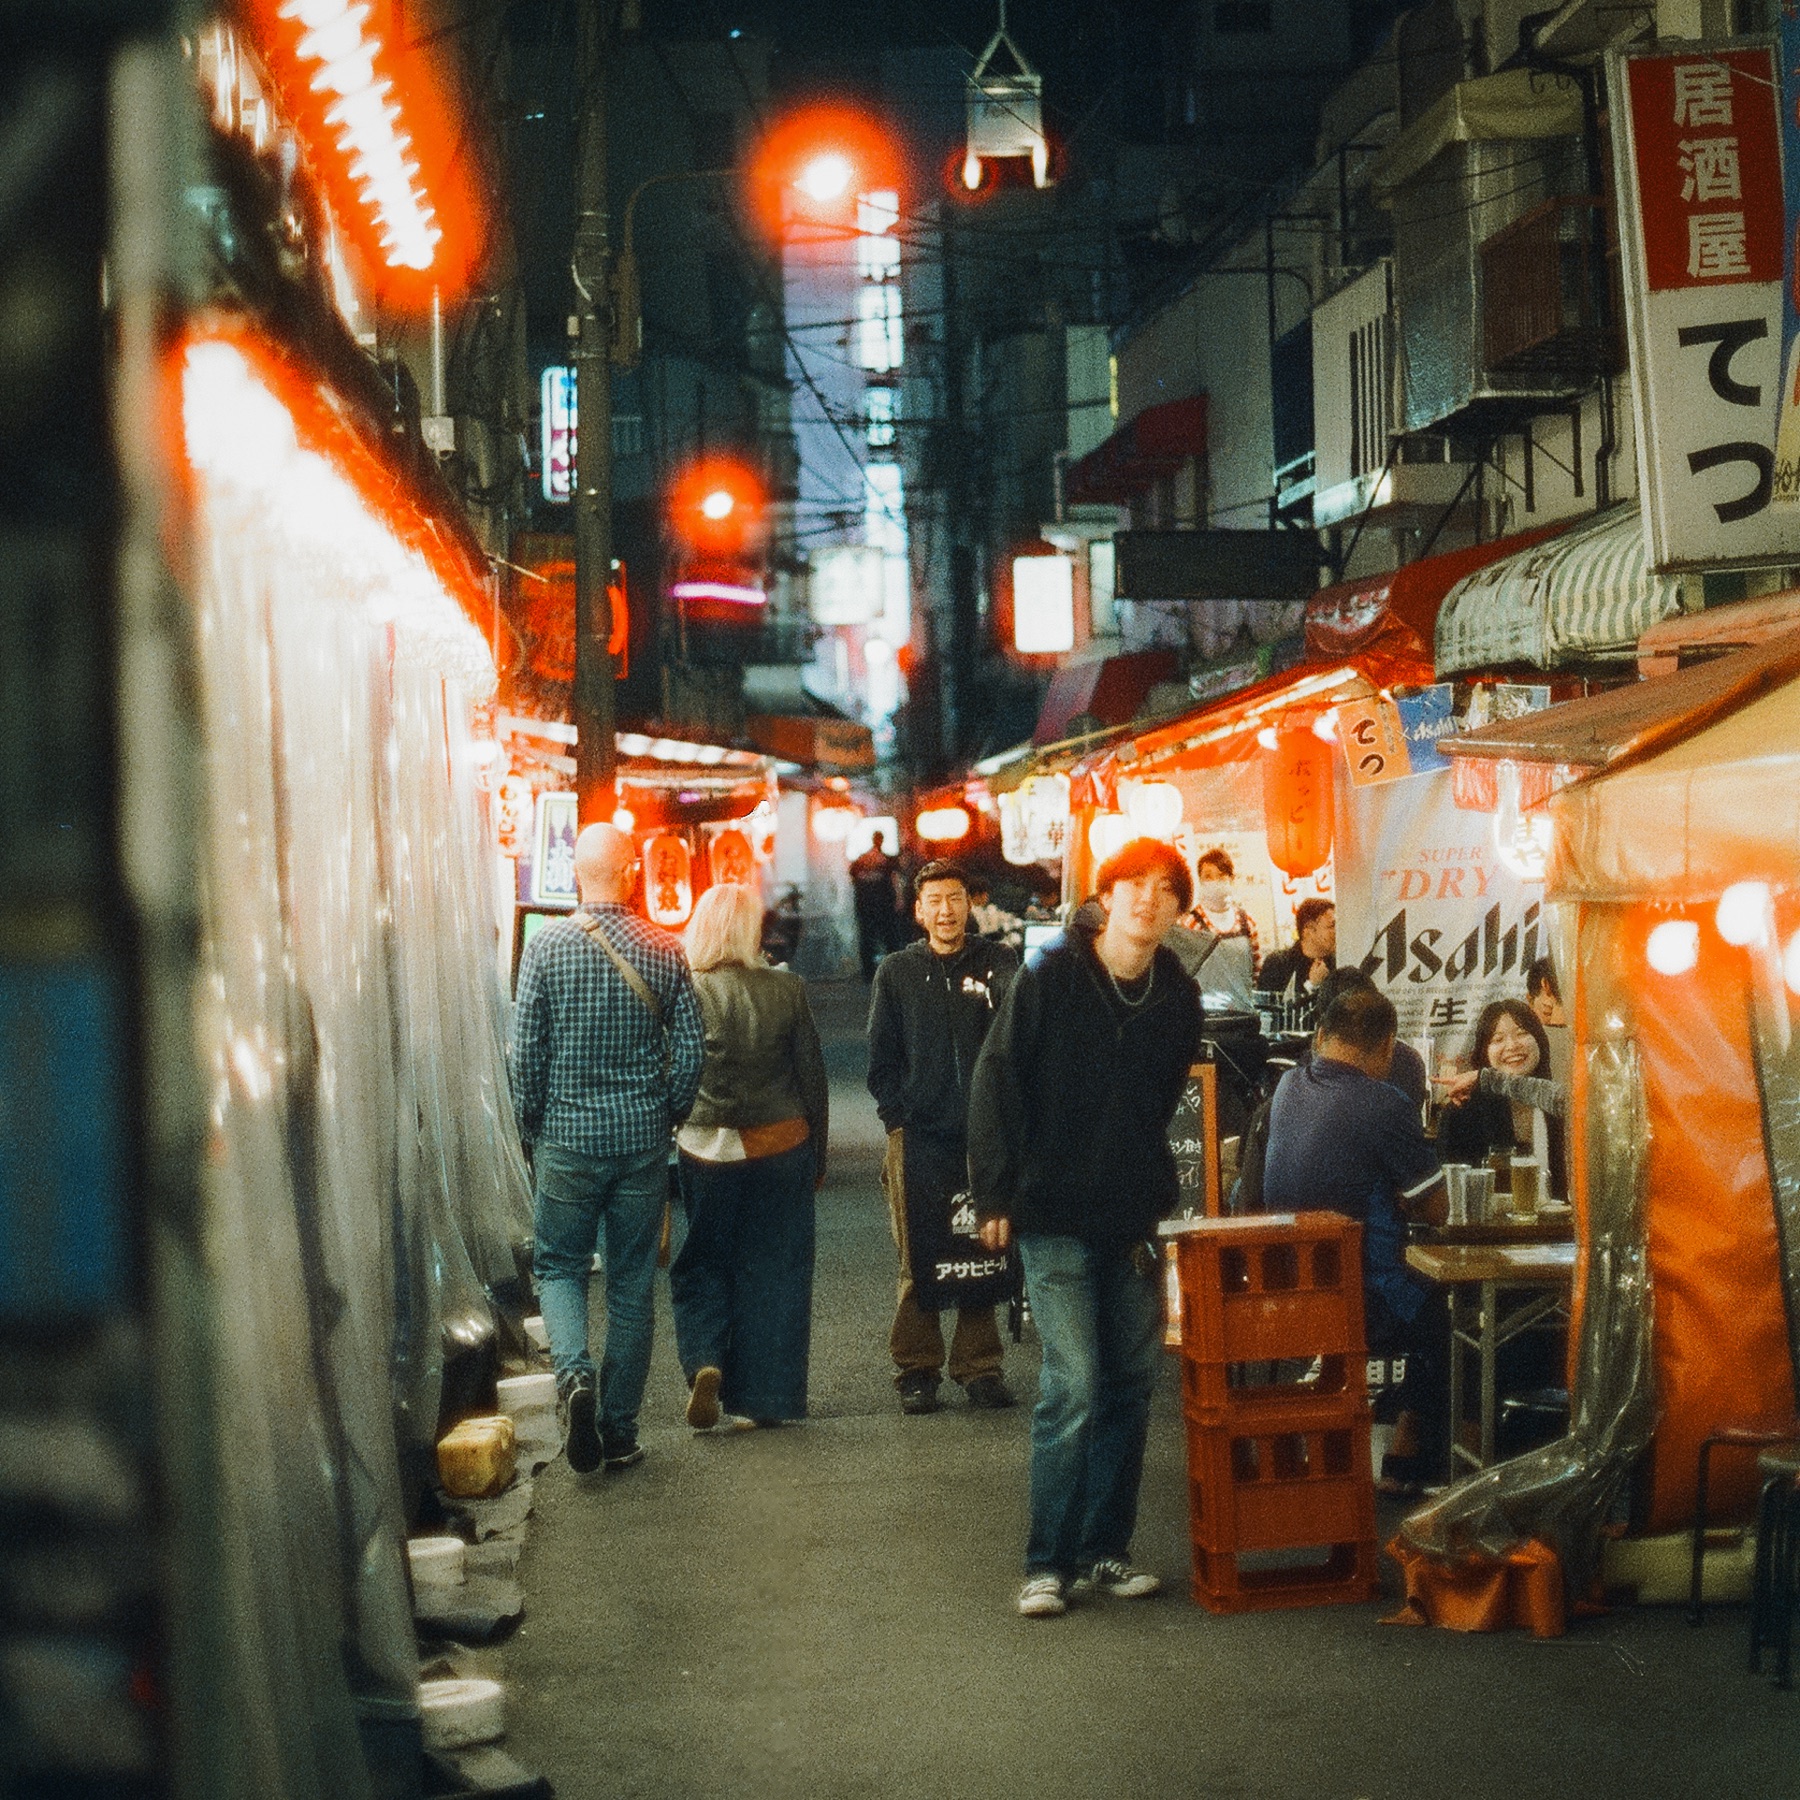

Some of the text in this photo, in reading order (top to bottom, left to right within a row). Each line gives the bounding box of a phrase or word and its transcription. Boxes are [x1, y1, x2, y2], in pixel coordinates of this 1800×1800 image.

[1672, 62, 1751, 278] 居酒屋
[1678, 317, 1776, 524] てつ
[1350, 718, 1385, 776] てつ
[1418, 846, 1484, 865] SUPER
[1358, 900, 1541, 985] Asahi
[1428, 997, 1468, 1028] 生
[935, 1255, 1008, 1280] アサヒビール
